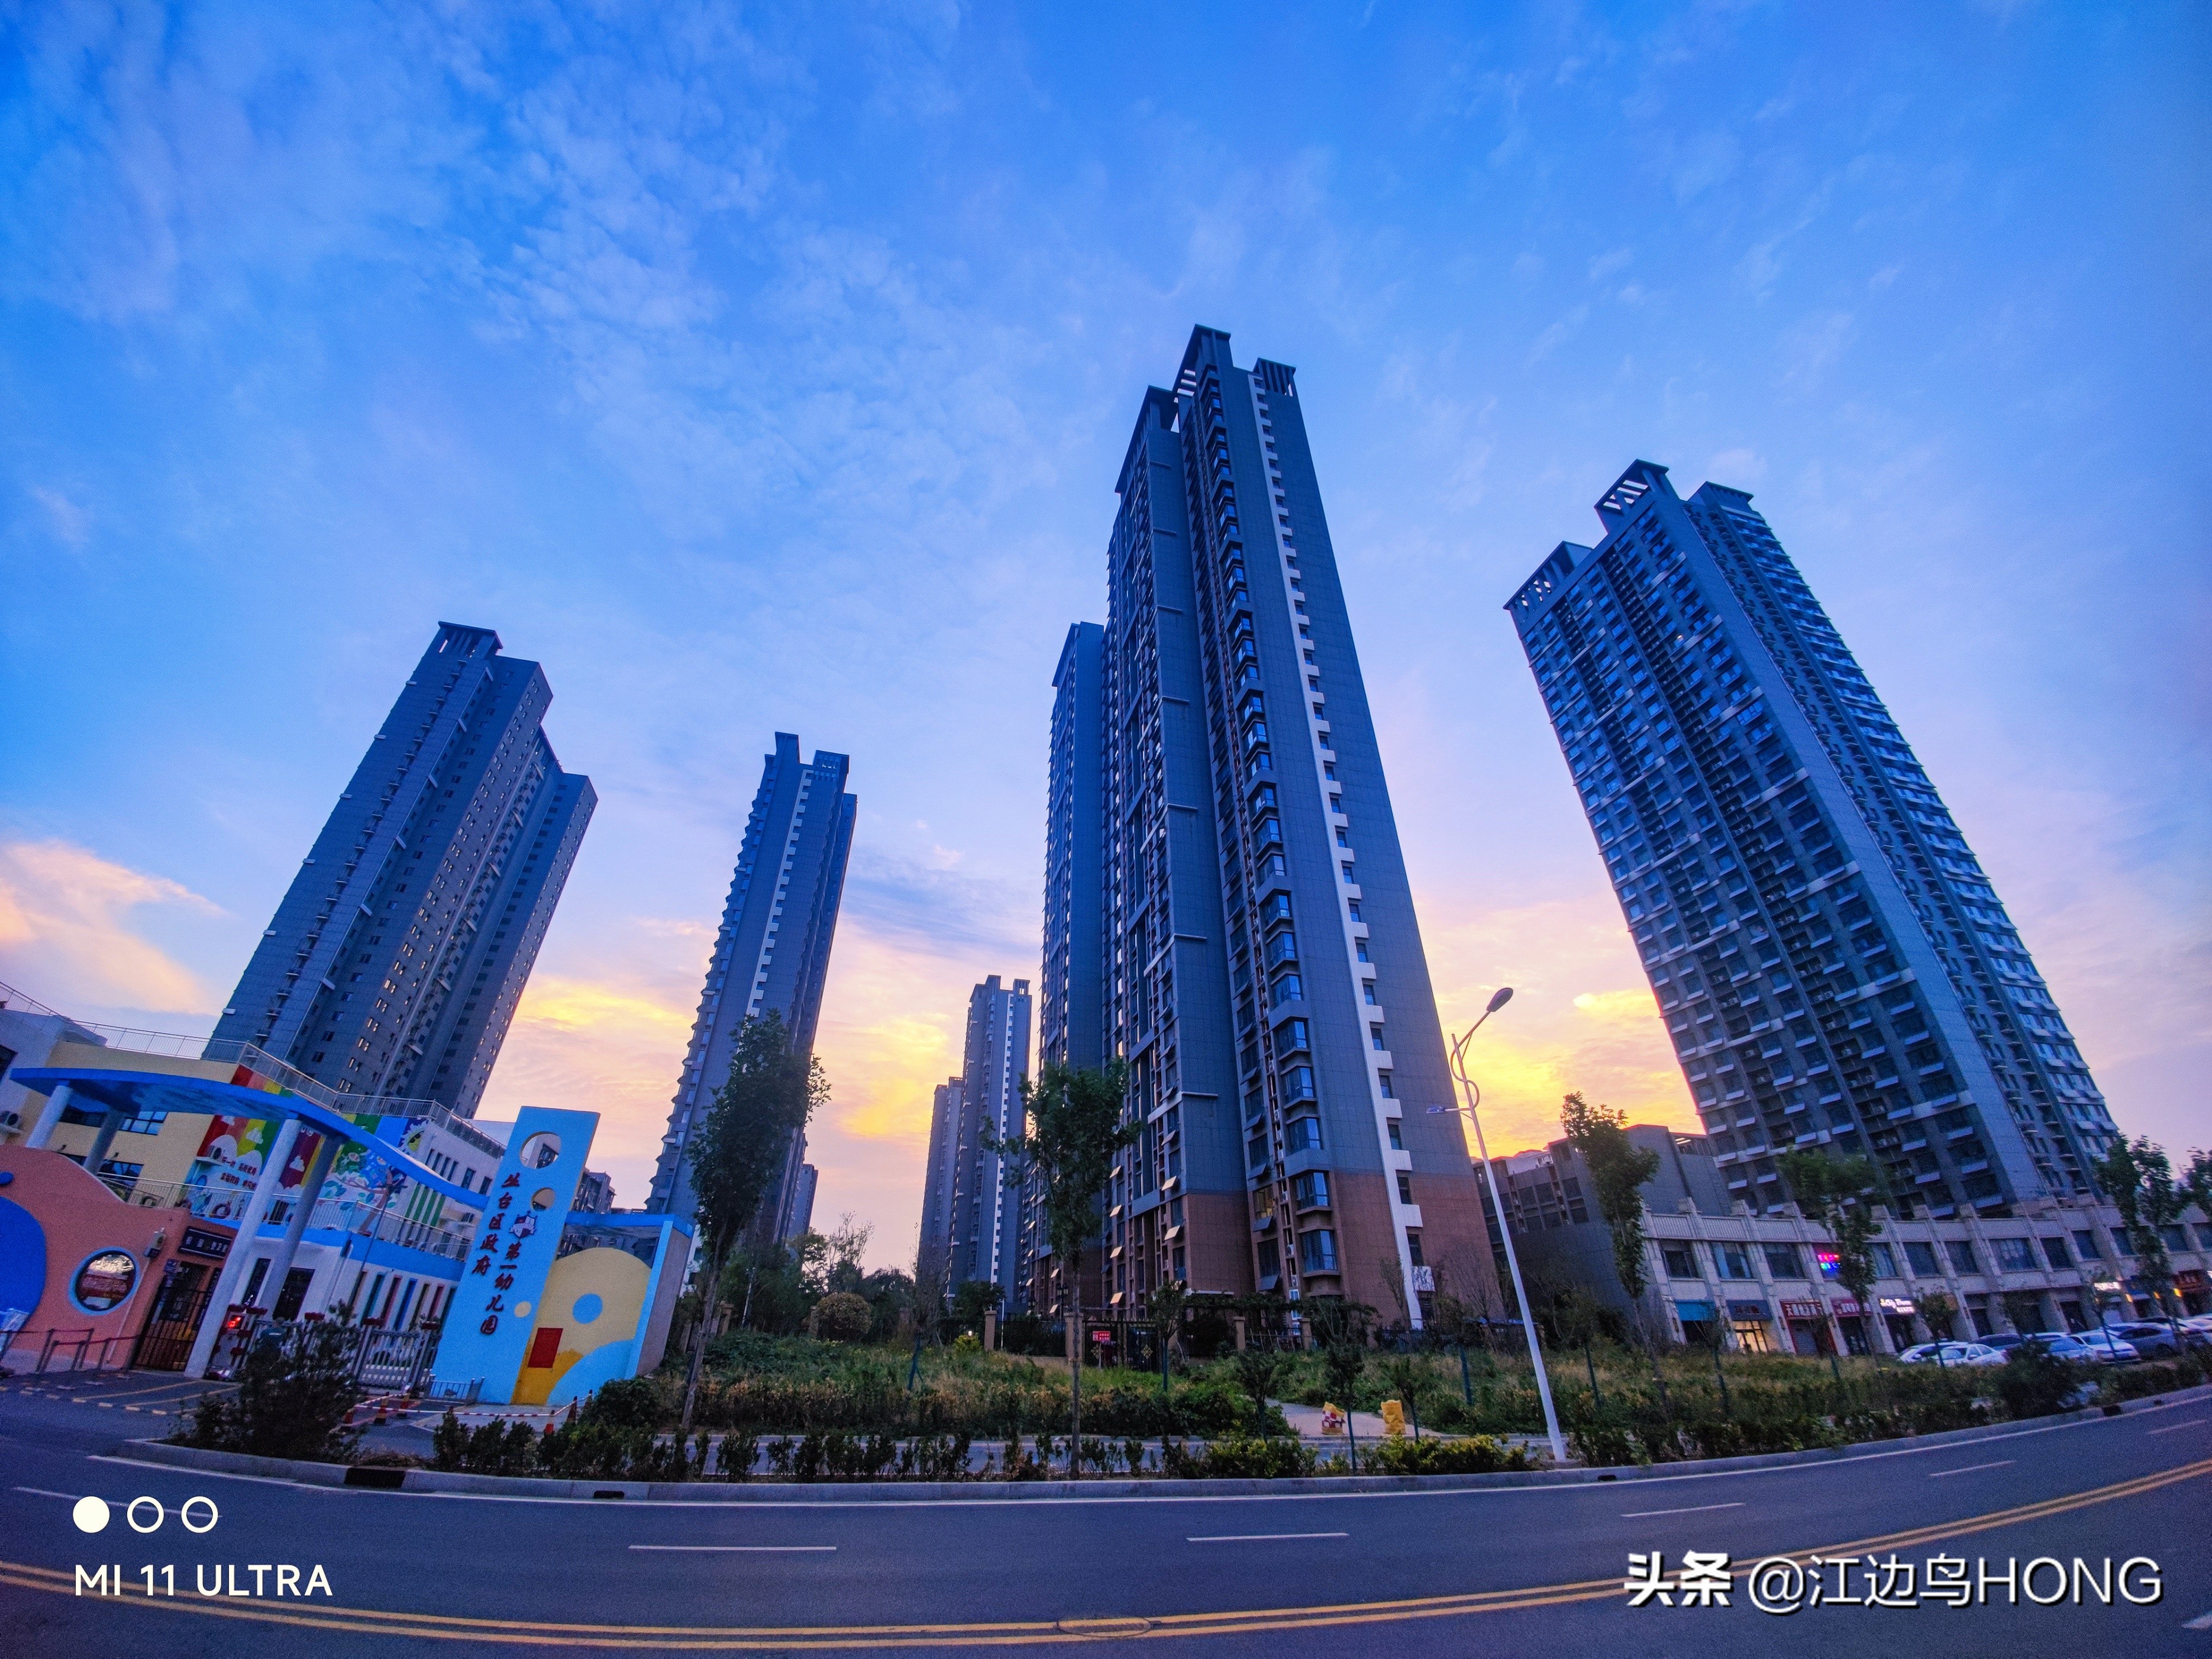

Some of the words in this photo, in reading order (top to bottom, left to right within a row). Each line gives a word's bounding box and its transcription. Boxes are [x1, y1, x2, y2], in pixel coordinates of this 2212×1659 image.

[480, 1241, 522, 1335] 第一幼儿园
